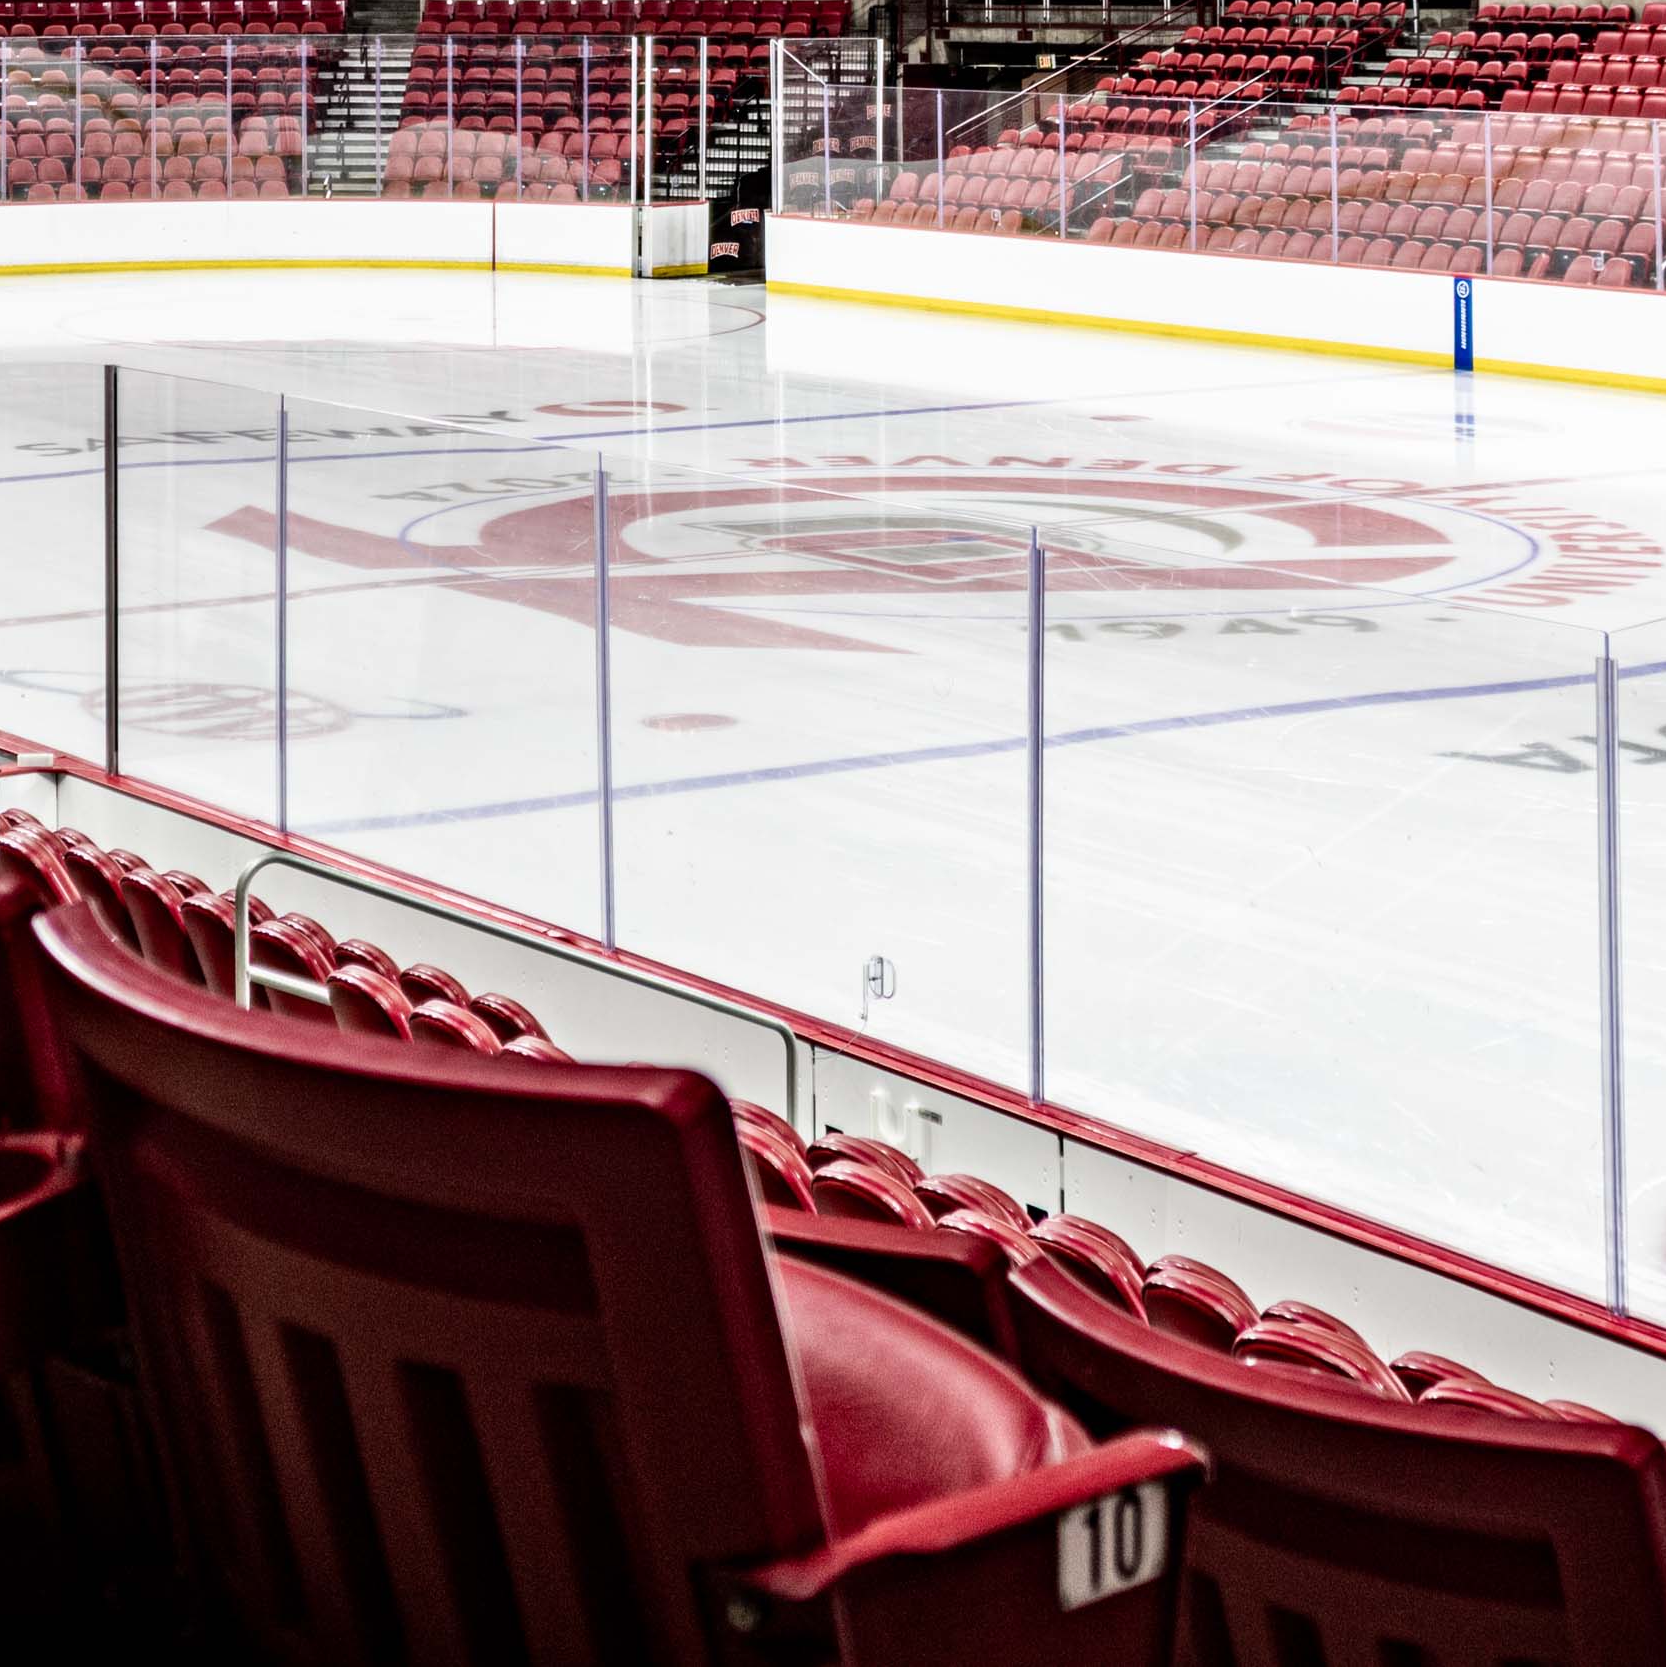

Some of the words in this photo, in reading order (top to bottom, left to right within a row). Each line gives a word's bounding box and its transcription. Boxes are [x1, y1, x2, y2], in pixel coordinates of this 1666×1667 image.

[15, 409, 525, 459] SAFEWAY
[733, 453, 1242, 476] DENVER
[1087, 1486, 1142, 1590] 10
